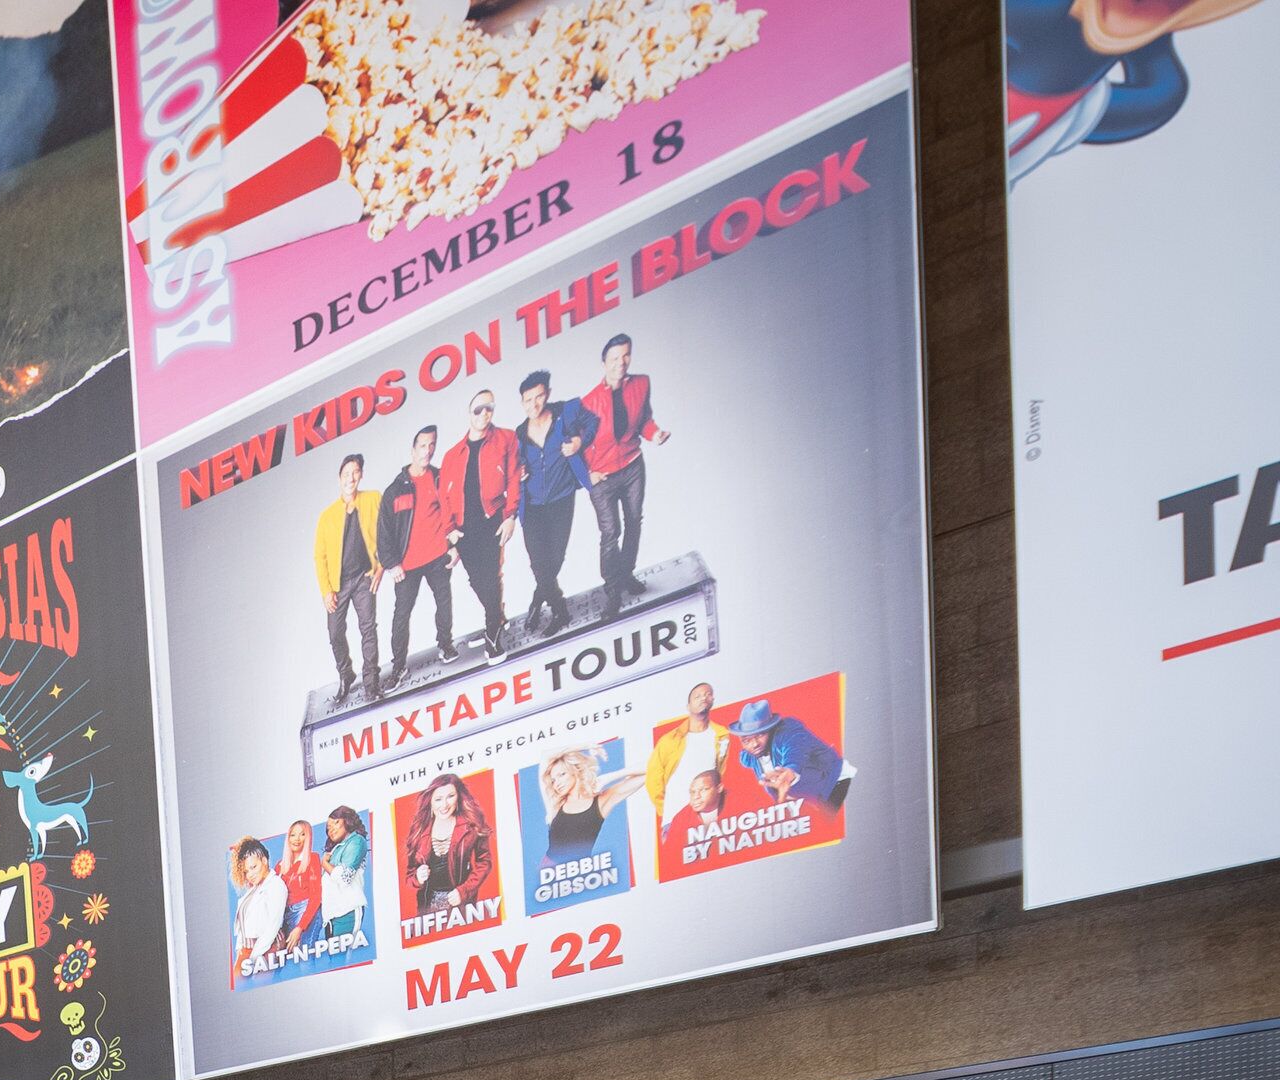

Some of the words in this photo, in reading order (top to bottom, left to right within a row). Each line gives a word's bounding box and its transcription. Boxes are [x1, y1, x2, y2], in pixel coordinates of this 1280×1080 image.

[291, 178, 575, 354] DECEMBER
[614, 118, 686, 187] 18
[179, 423, 286, 511] NEW
[293, 367, 408, 459] KIDS
[418, 317, 504, 396] ON
[516, 259, 621, 350] THE
[632, 137, 872, 300] BLOCK
[1026, 398, 1041, 444] Disney
[342, 669, 534, 764] MIXTAPE
[544, 620, 681, 692] TOUR
[683, 612, 698, 645] 2019
[389, 768, 428, 786] WITH
[436, 751, 476, 772] VERY
[485, 726, 557, 757] SPECIAL
[566, 701, 634, 731] GUESTS
[682, 840, 715, 865] BY
[717, 814, 812, 857] NATURE
[686, 798, 805, 846] NAUGHTY
[534, 868, 619, 904] GIBSON
[540, 851, 613, 886] DEBBIE
[400, 896, 503, 940] TIFFANY
[241, 930, 369, 978] SALT-N-PEPA
[406, 944, 528, 1012] MAY
[551, 923, 624, 980] 22
